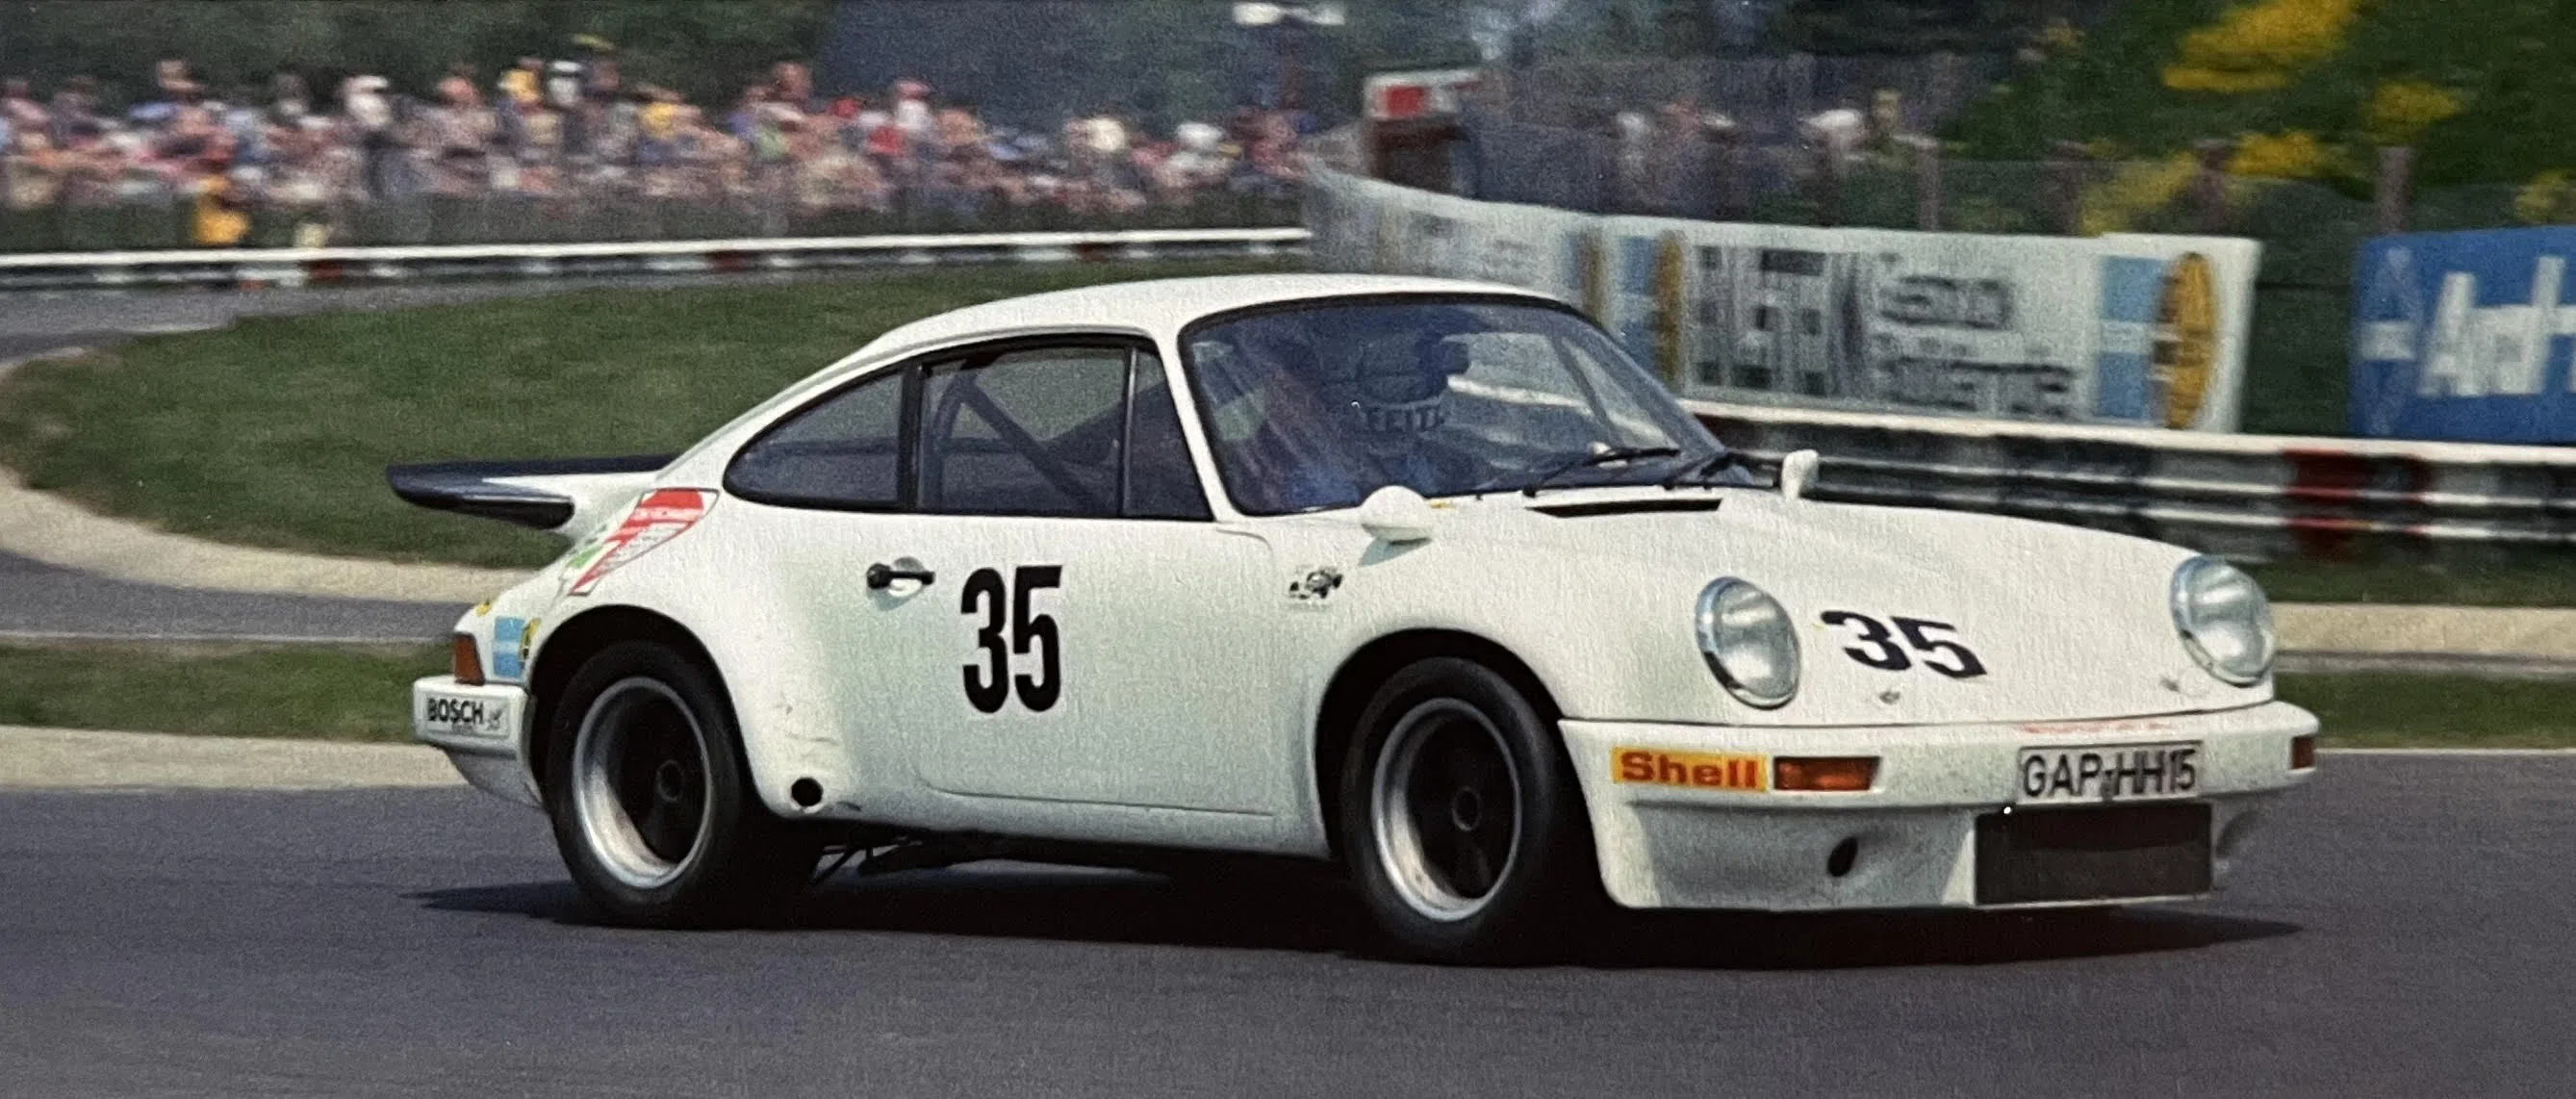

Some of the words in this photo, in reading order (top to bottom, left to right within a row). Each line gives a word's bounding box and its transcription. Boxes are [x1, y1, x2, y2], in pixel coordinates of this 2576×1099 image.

[960, 565, 1063, 714] 35
[1820, 609, 1988, 679] 35
[426, 697, 485, 725] BOSCH
[1620, 751, 1759, 788] Shell
